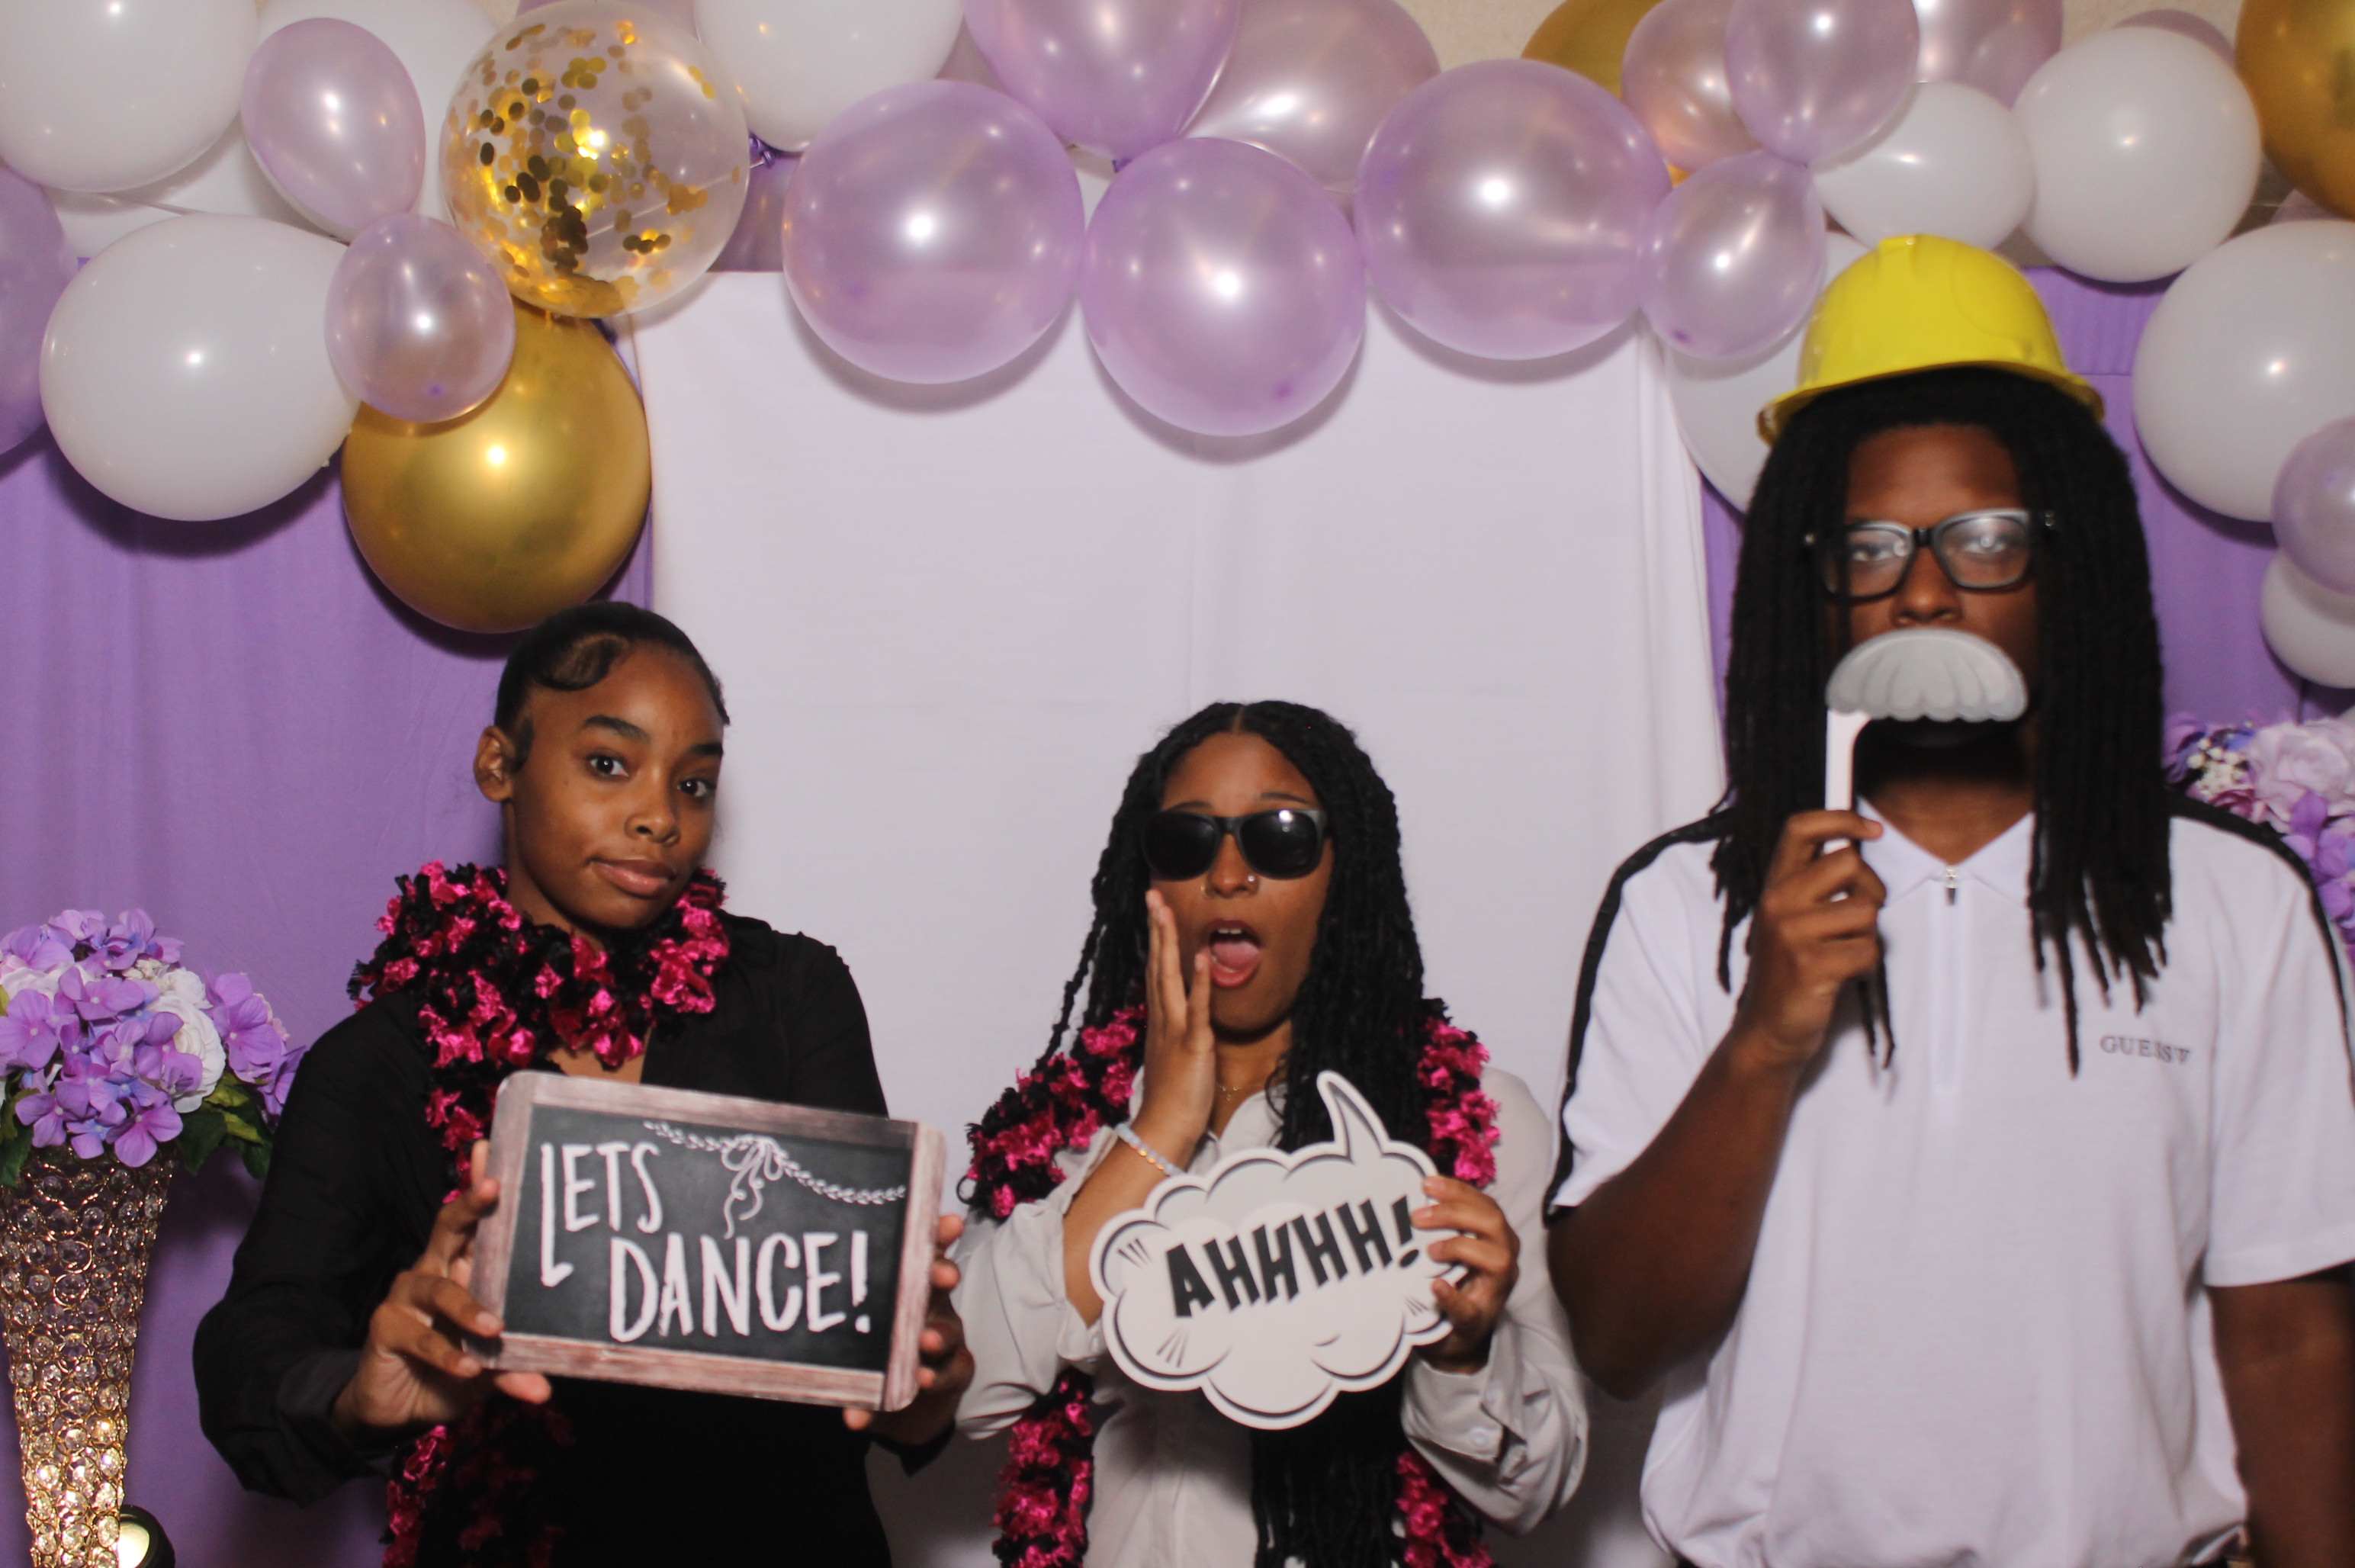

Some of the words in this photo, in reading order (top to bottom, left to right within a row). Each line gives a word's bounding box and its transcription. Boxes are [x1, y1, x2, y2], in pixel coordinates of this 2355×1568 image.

[540, 1142, 663, 1287] LETS
[1165, 1194, 1421, 1318] AHHHH!
[610, 1229, 871, 1342] DANCE!
